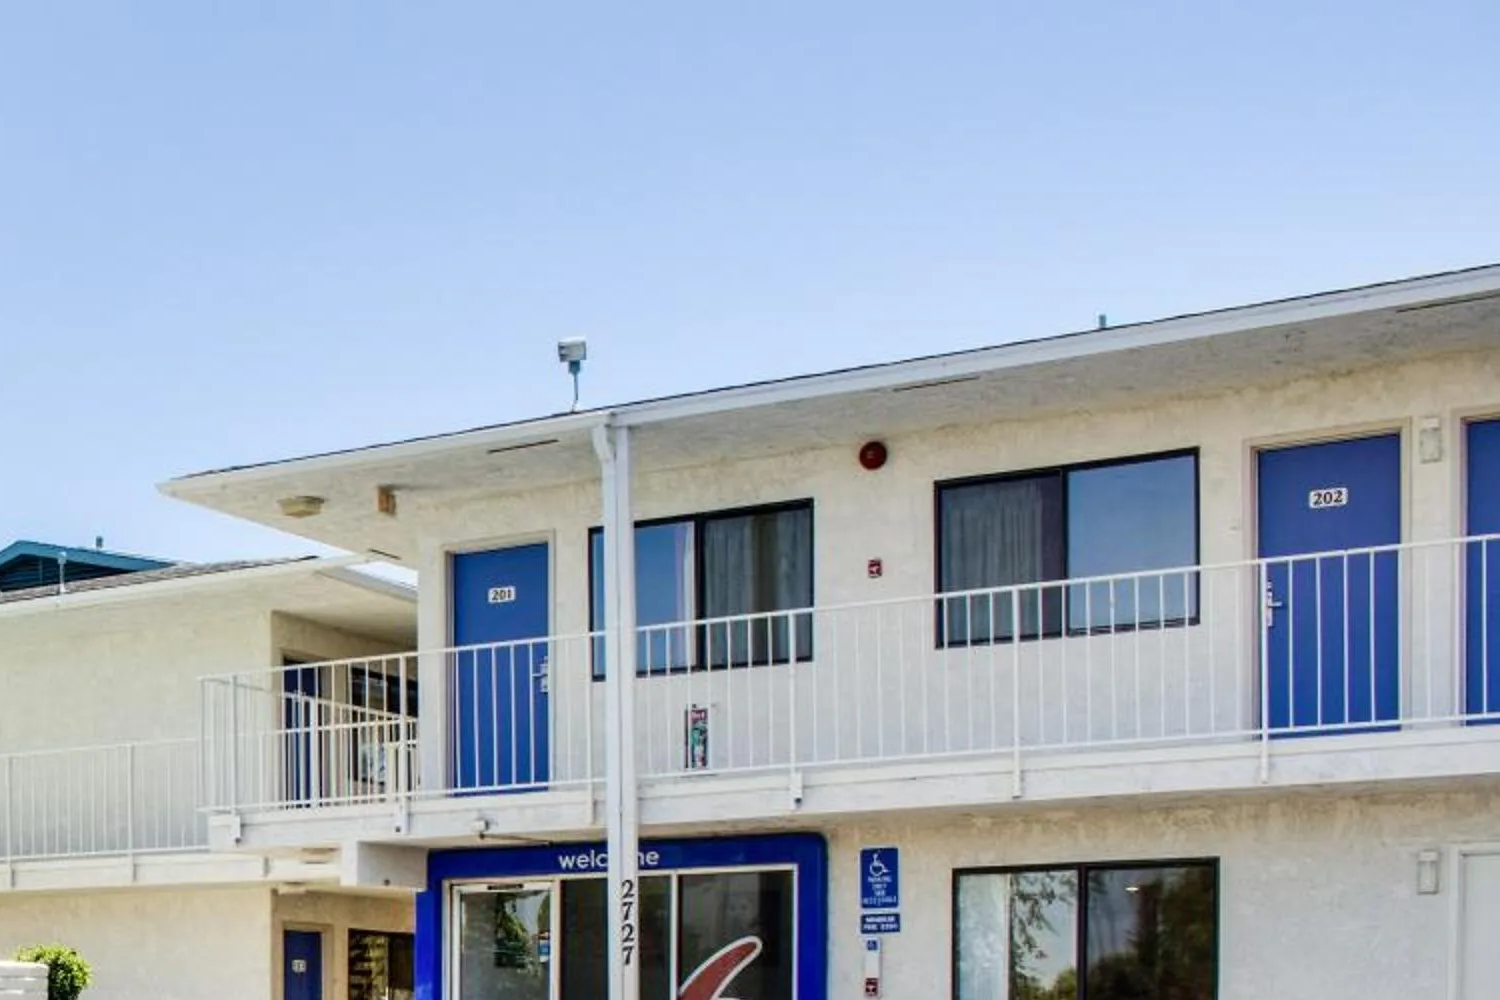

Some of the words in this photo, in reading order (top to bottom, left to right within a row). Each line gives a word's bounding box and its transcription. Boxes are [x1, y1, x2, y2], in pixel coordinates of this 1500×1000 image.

[1313, 489, 1343, 506] 202
[491, 589, 512, 601] 201
[559, 849, 660, 869] welce
[621, 879, 635, 965] 2727
